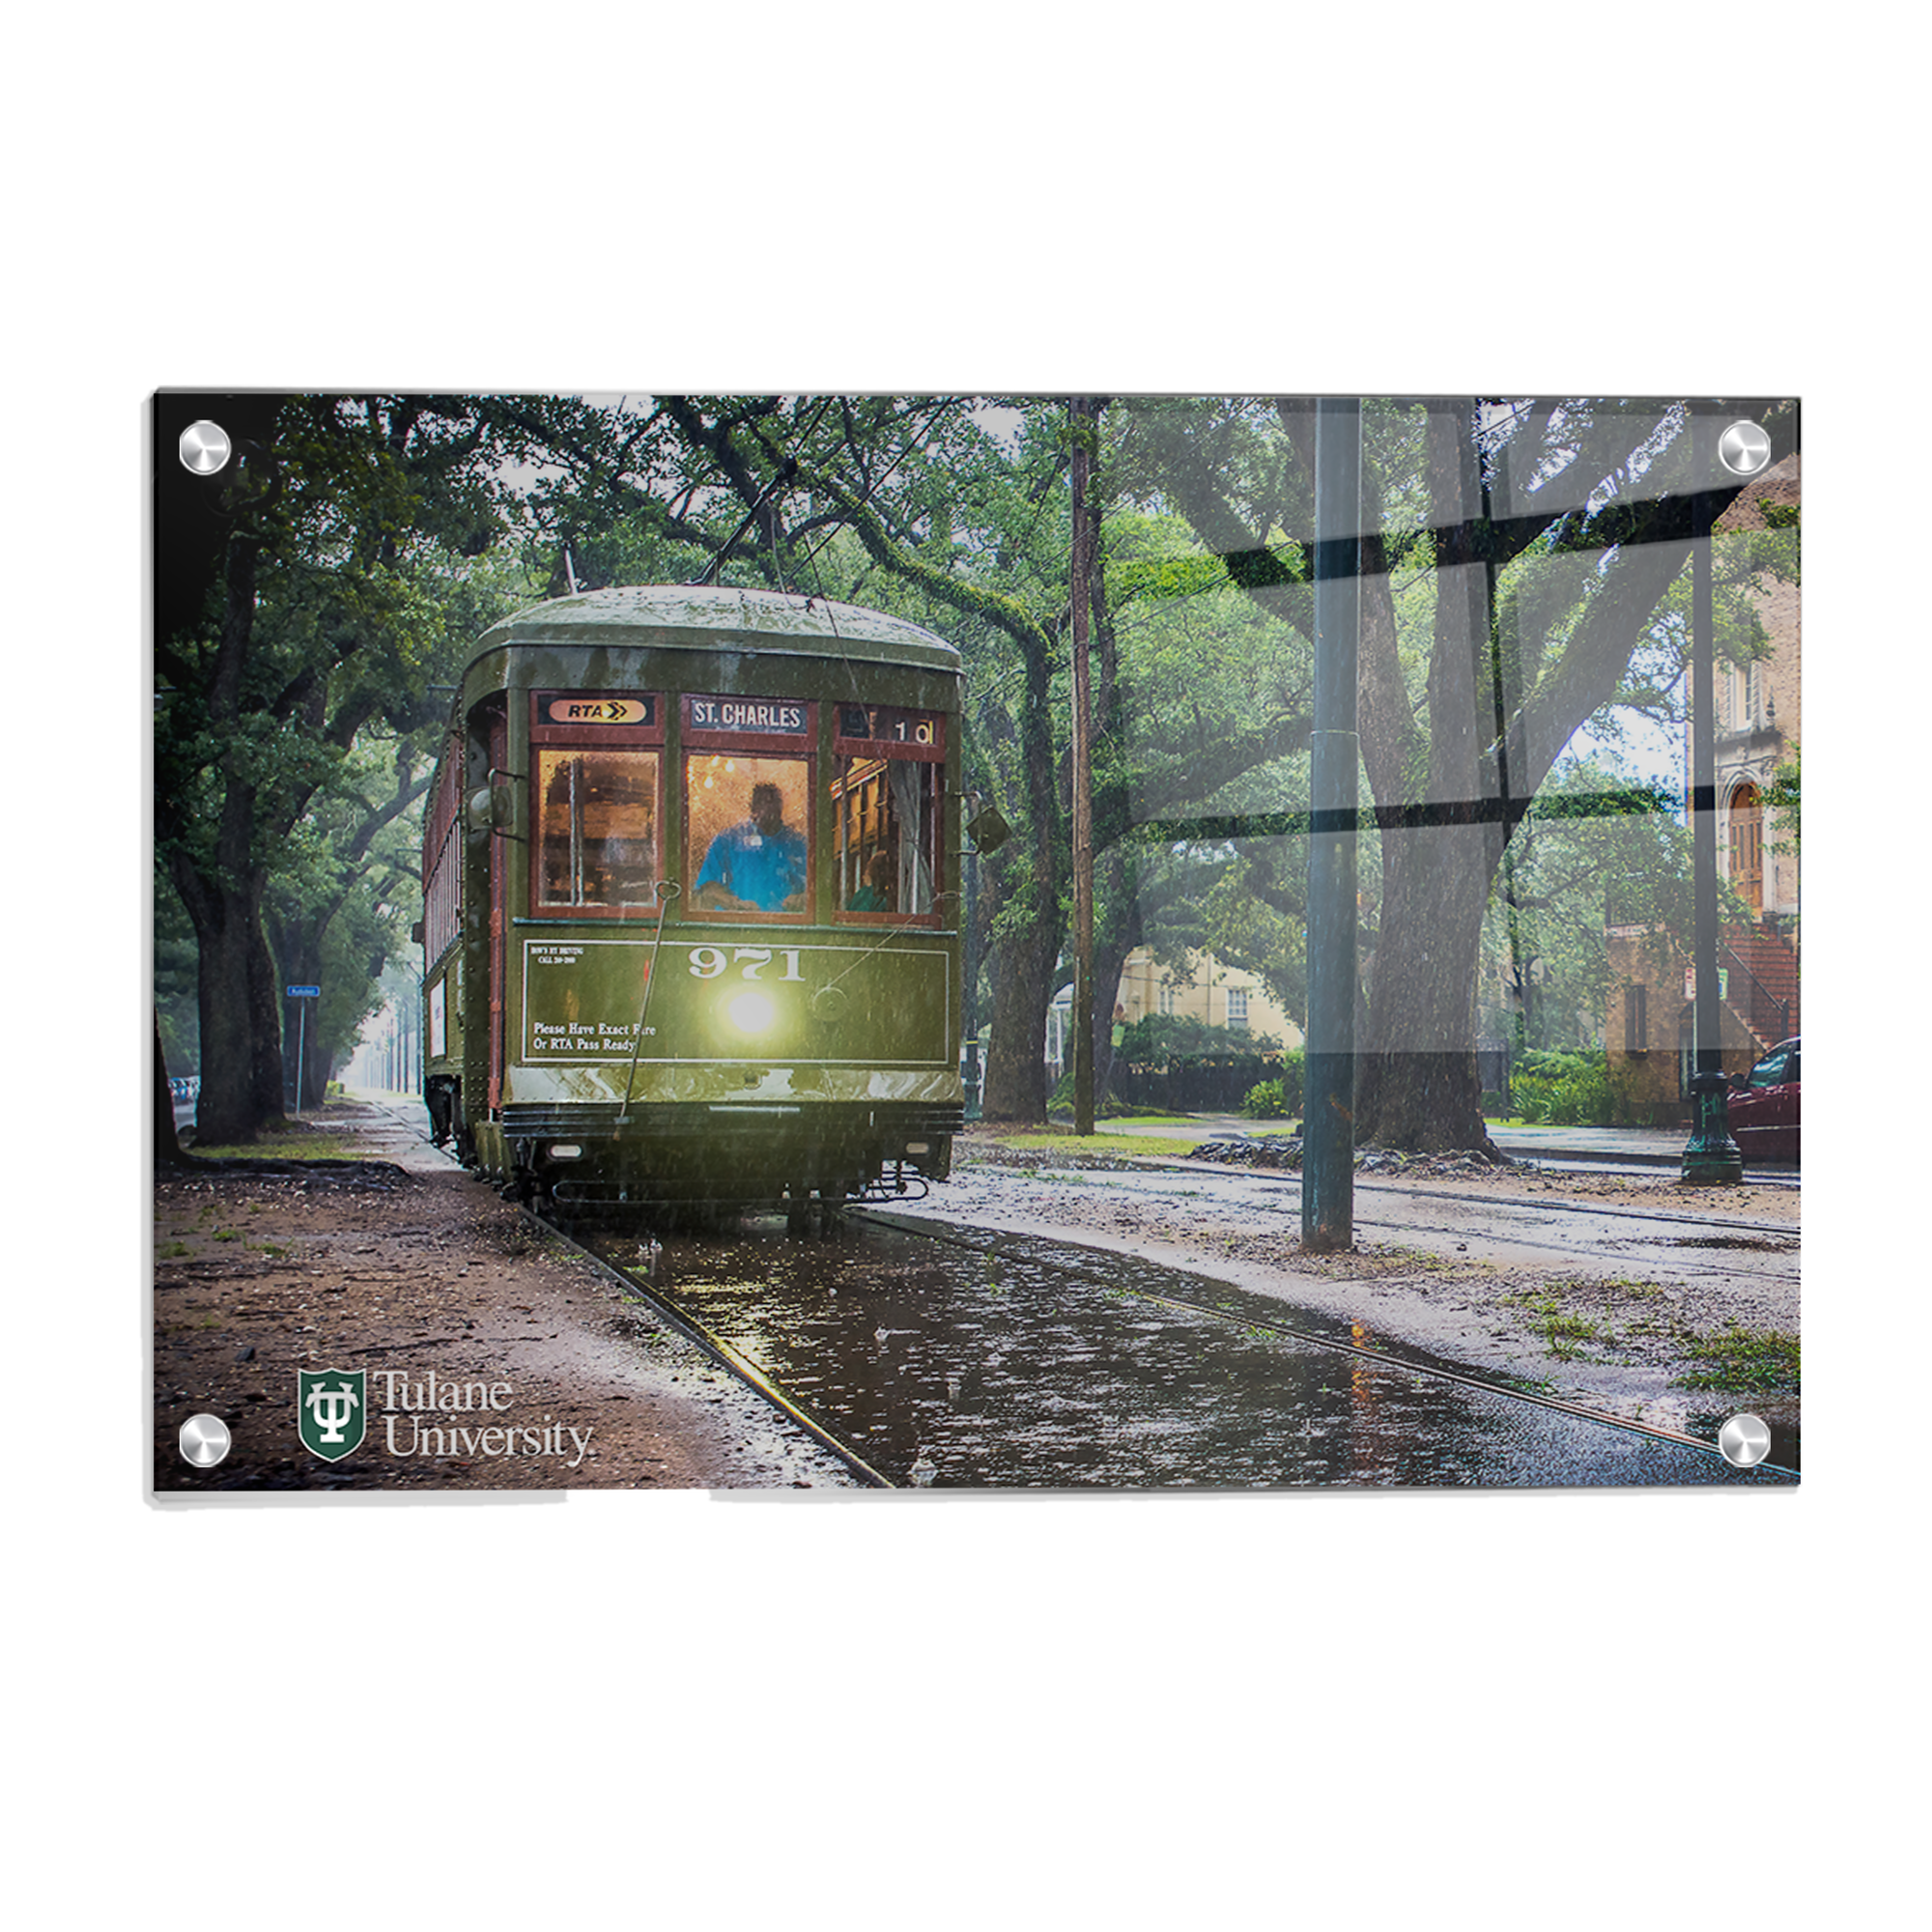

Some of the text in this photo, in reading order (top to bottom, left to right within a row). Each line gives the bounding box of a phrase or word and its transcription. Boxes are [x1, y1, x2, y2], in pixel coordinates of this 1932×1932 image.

[568, 704, 604, 718] RTA
[694, 702, 801, 727] ST. CHARLES
[688, 947, 806, 981] 971
[533, 1022, 565, 1035] Please
[569, 1022, 595, 1035] Have
[598, 1023, 629, 1035] Exact
[533, 1037, 636, 1053] Or RTA Pass Ready
